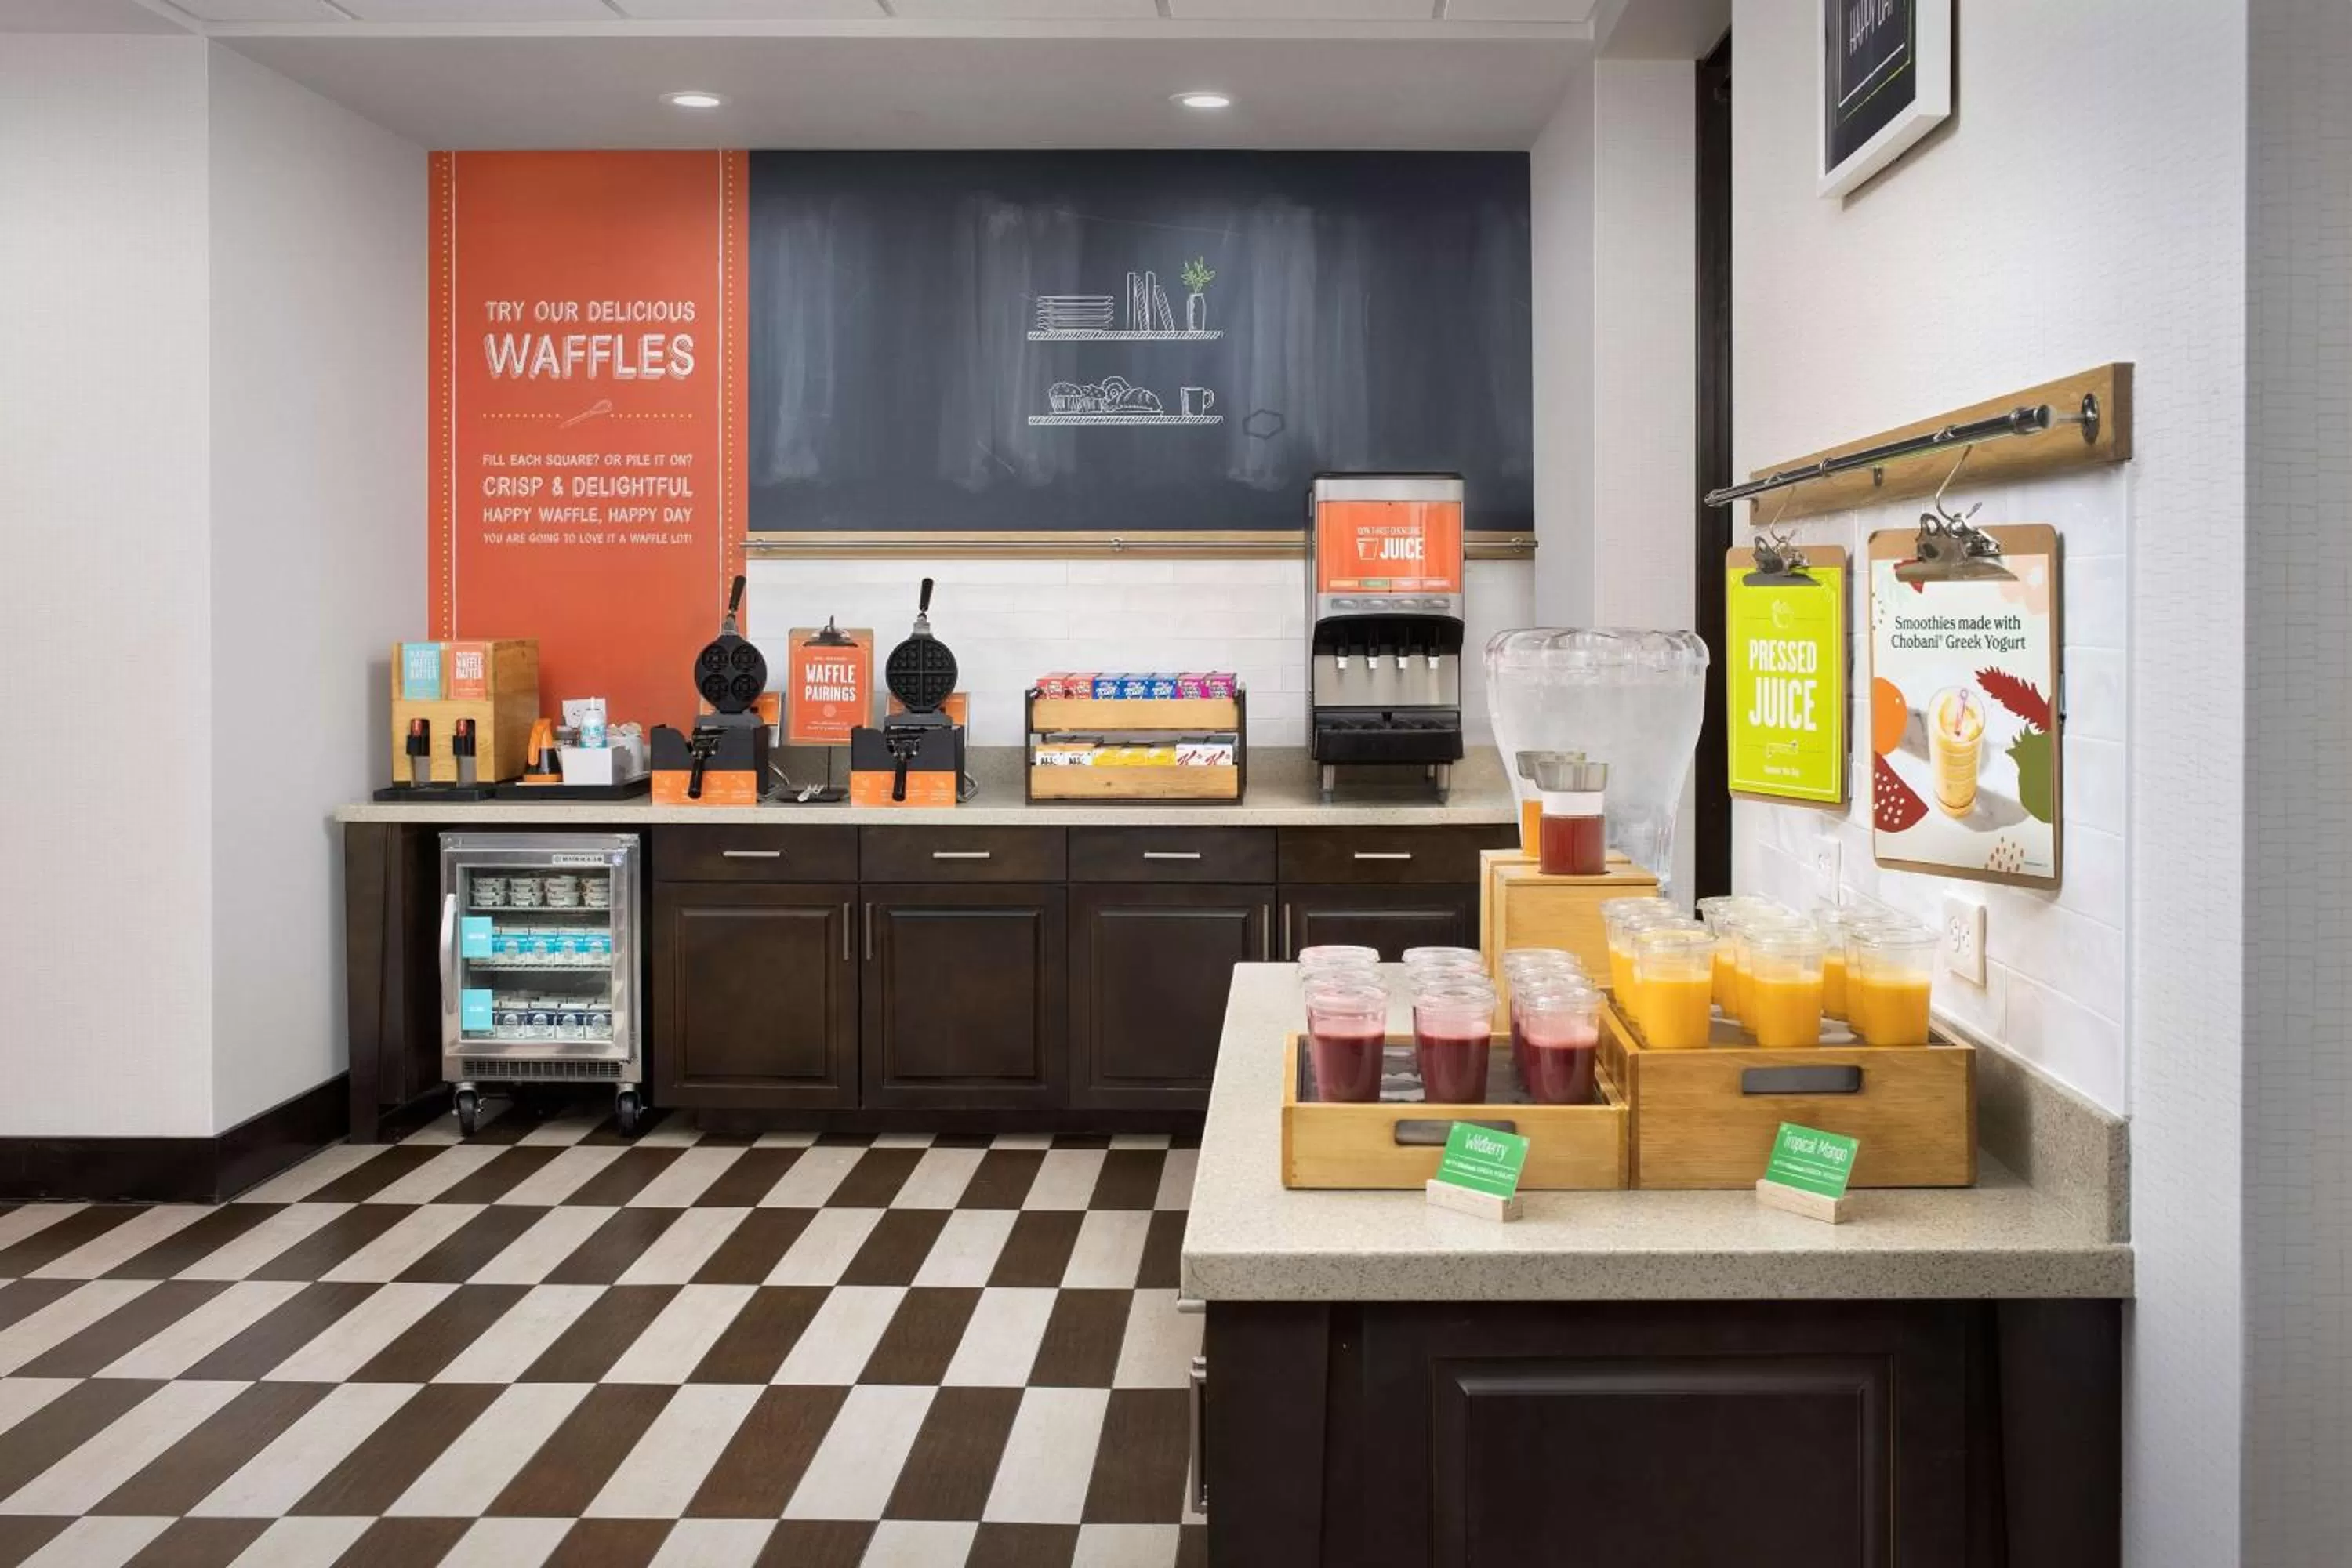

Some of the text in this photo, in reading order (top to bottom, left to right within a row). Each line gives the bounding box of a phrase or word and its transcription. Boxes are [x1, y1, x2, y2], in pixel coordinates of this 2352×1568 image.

[485, 300, 695, 323] TRY OUR DELICIOUS
[484, 333, 695, 380] WAFFLES
[482, 453, 693, 466] FILL EACH SQUARE? OR PILE IT ON?
[483, 476, 693, 498] CRISP & DELIGHTFUL
[483, 506, 693, 524] HAPPY WAFFLE, HAPPY DAY
[483, 532, 503, 543] YOU
[506, 532, 526, 543] ARE
[528, 532, 560, 543] GOING
[563, 532, 576, 543] TO
[579, 532, 603, 543] LOVE
[607, 532, 615, 543] IT
[619, 532, 626, 543] A
[630, 532, 668, 543] WAFFLE
[1380, 537, 1424, 560] JUICE
[1895, 615, 2021, 630] Smoothies made with
[1945, 634, 1982, 649] Greek
[1984, 634, 2026, 653] Yogurt
[1749, 638, 1817, 674] PRESSED
[805, 663, 856, 684] WAFFLE
[804, 686, 856, 702] PAIRINGS
[1748, 677, 1817, 731] JUICE
[1784, 1131, 1848, 1165] Tropical Mango
